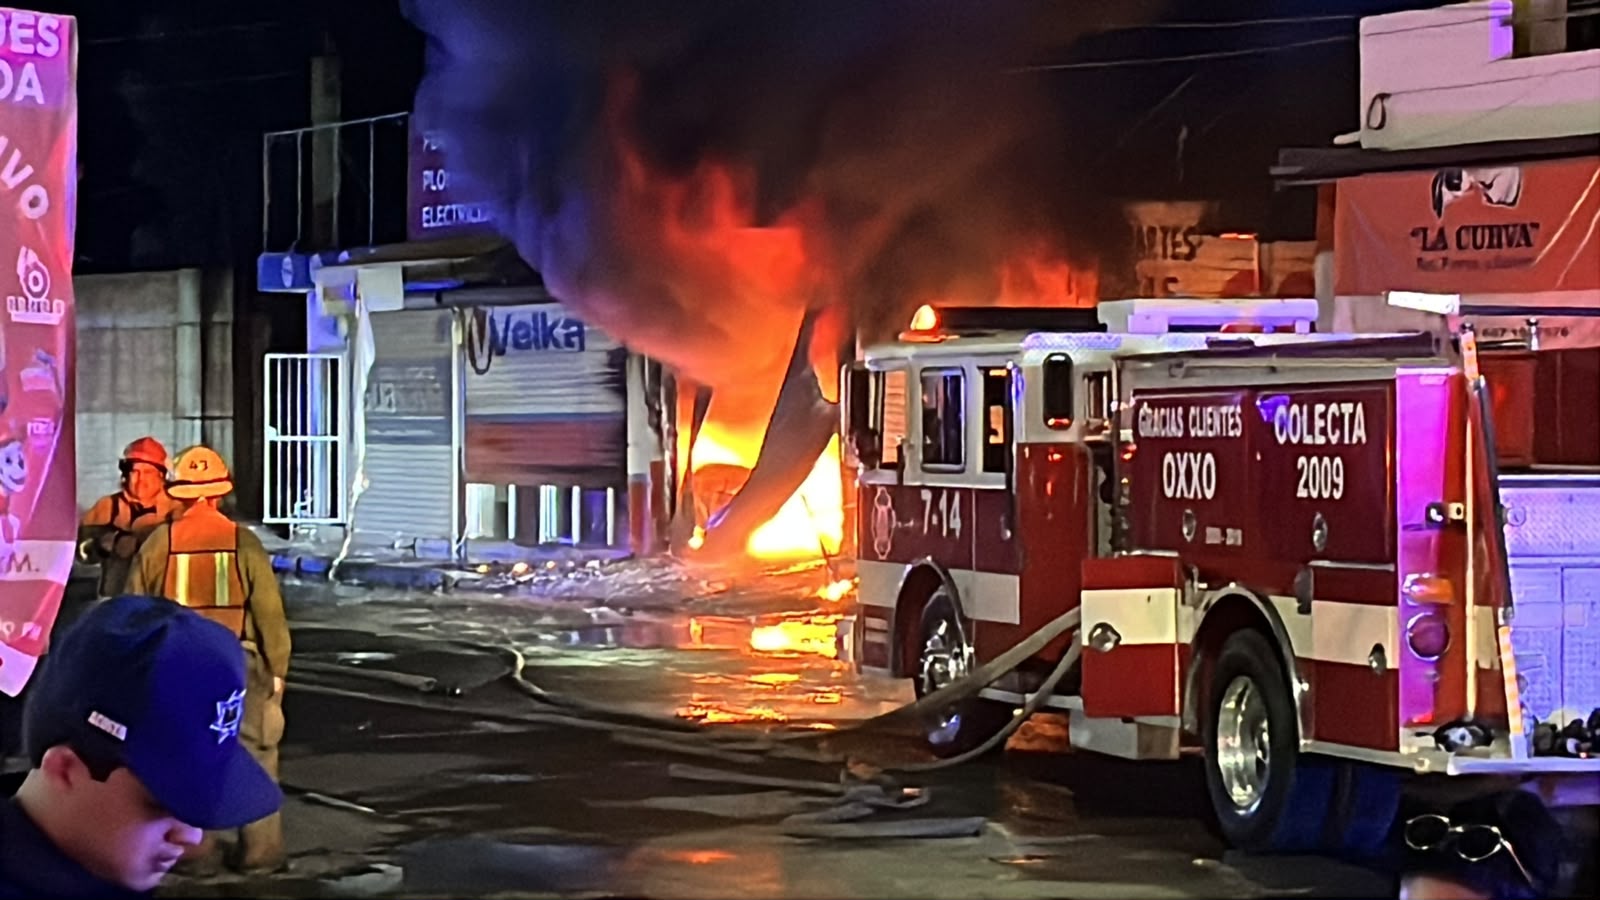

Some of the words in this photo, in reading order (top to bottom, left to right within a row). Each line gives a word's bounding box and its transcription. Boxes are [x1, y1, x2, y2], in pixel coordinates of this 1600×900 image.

[0, 12, 60, 57] ES
[1138, 402, 1184, 438] GRACIAS
[1189, 404, 1242, 438] CLIENTES
[1274, 402, 1367, 445] COLECTA
[1163, 452, 1217, 499] OXXO
[1296, 456, 1344, 499] 2009
